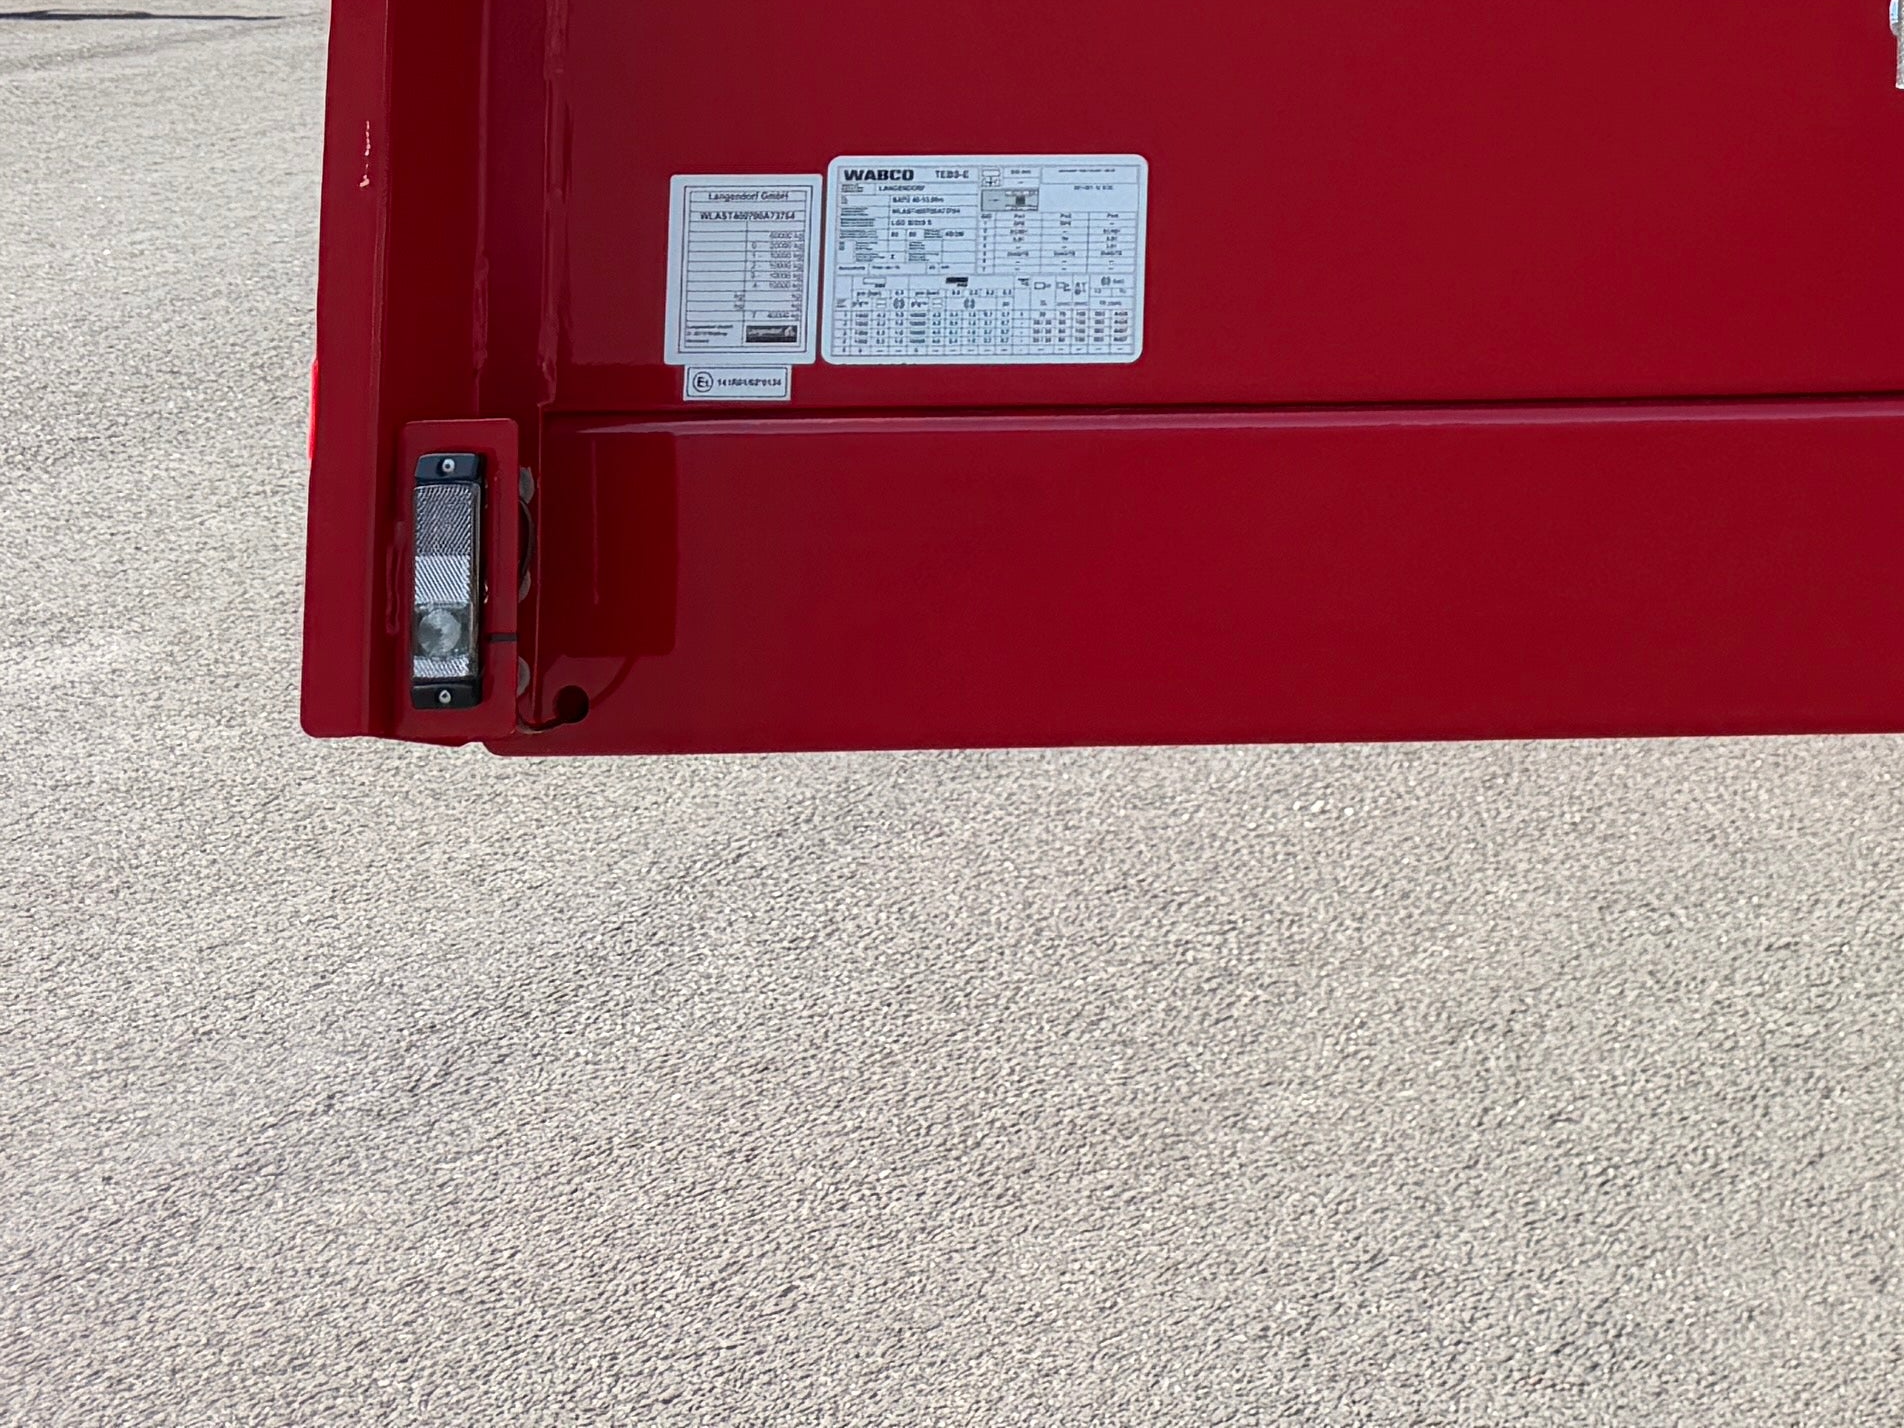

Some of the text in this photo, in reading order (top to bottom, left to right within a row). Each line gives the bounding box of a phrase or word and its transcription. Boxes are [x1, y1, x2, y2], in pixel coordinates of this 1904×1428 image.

[844, 170, 914, 180] WABCO
[708, 191, 788, 202] Langendorf GmbH
